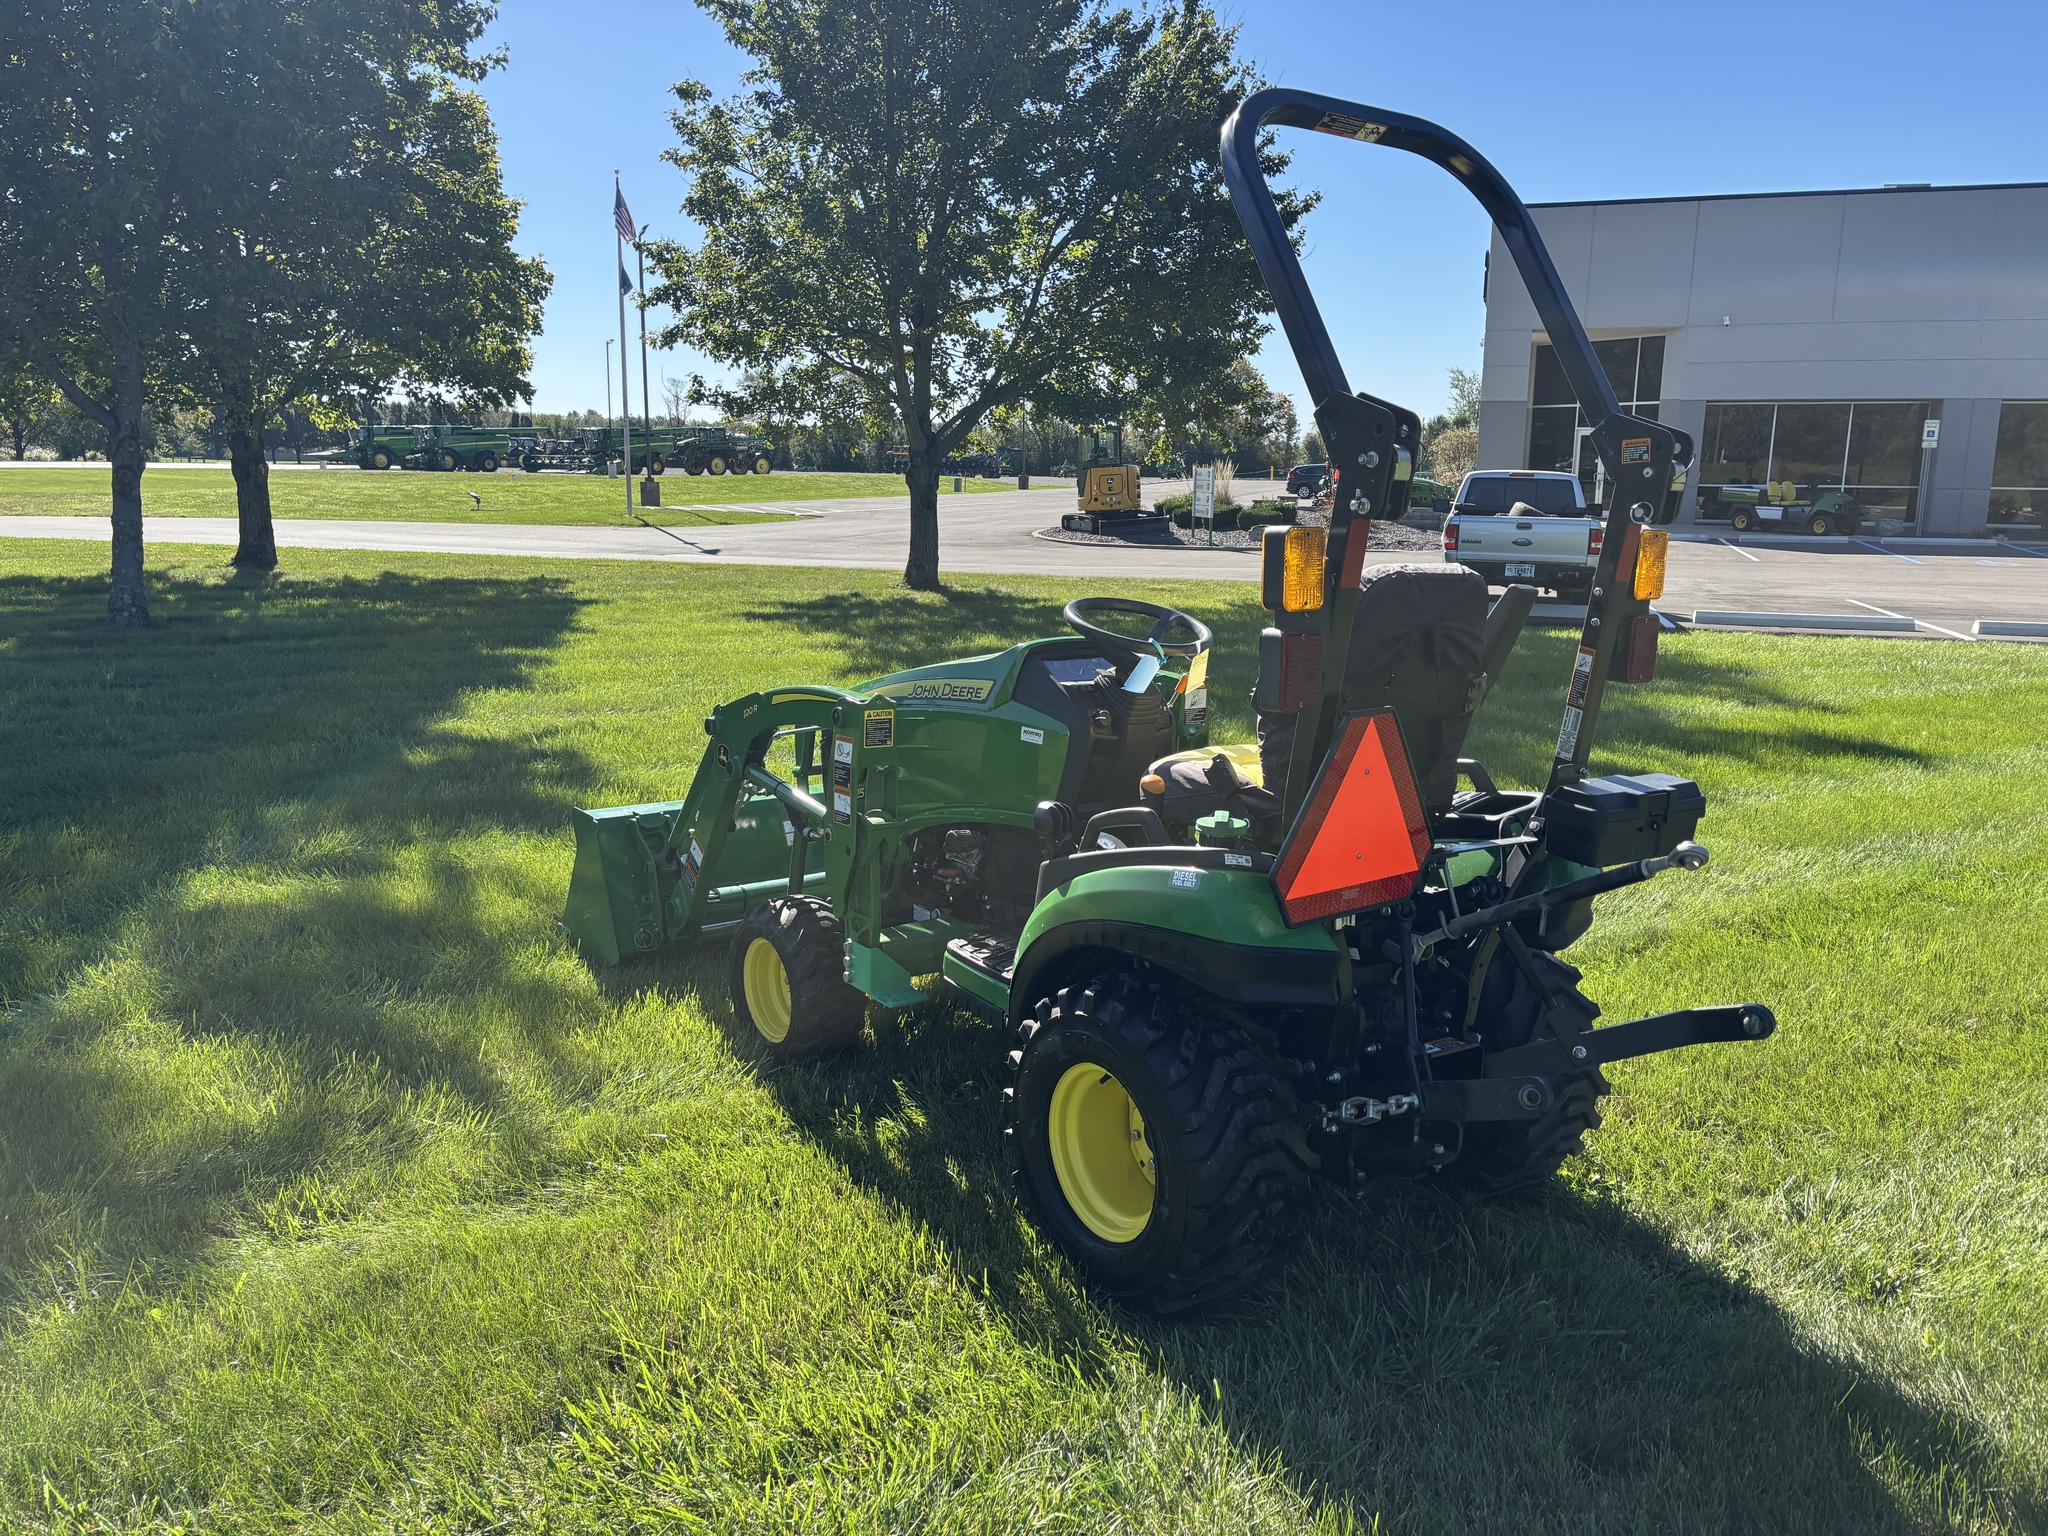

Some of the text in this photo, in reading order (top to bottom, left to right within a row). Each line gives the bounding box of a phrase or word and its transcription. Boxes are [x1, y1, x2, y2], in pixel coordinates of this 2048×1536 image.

[908, 683, 984, 699] JOHN DEERE
[872, 710, 893, 718] CAUTION
[1173, 870, 1197, 882] DIESEL
[1171, 879, 1196, 888] FUEL ONLY
